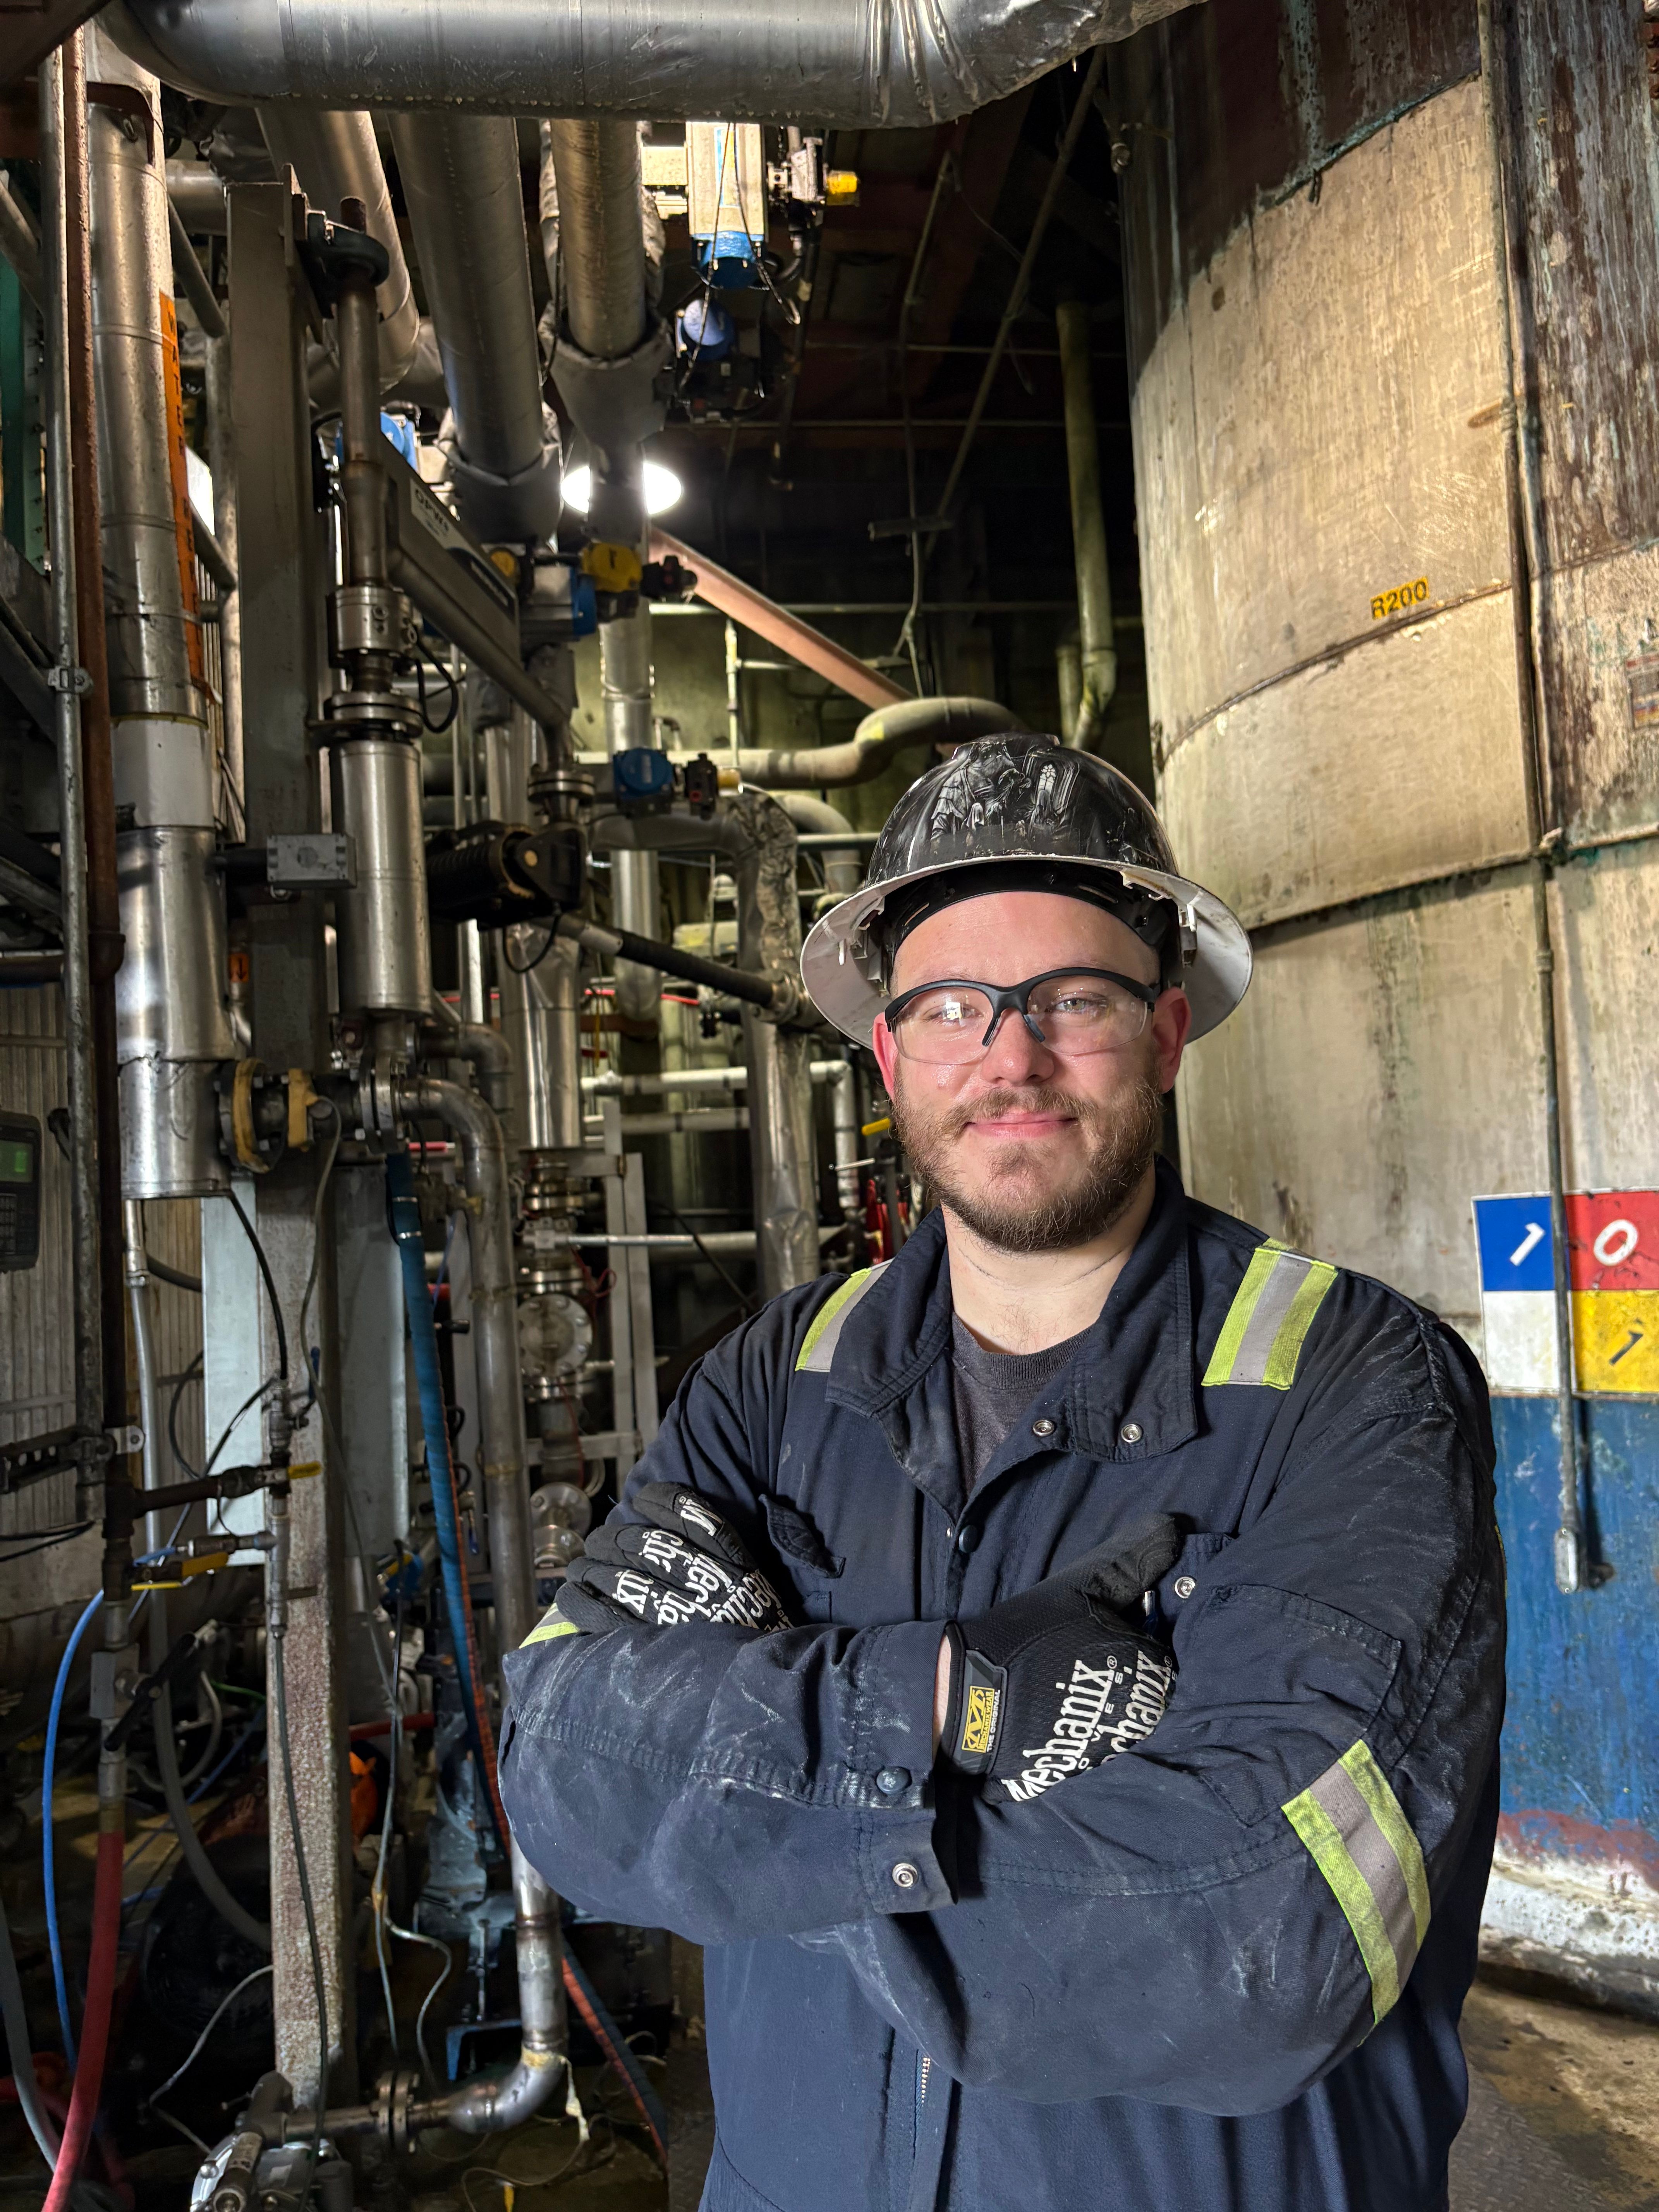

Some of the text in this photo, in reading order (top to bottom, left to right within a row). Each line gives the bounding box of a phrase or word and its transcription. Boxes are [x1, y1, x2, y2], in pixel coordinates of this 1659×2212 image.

[167, 311, 185, 456] WATER
[1372, 581, 1427, 619] R200
[1510, 1219, 1638, 1266] 1 0
[1608, 1330, 1644, 1366] 1
[986, 1689, 1000, 1752] THE ORIGINAL
